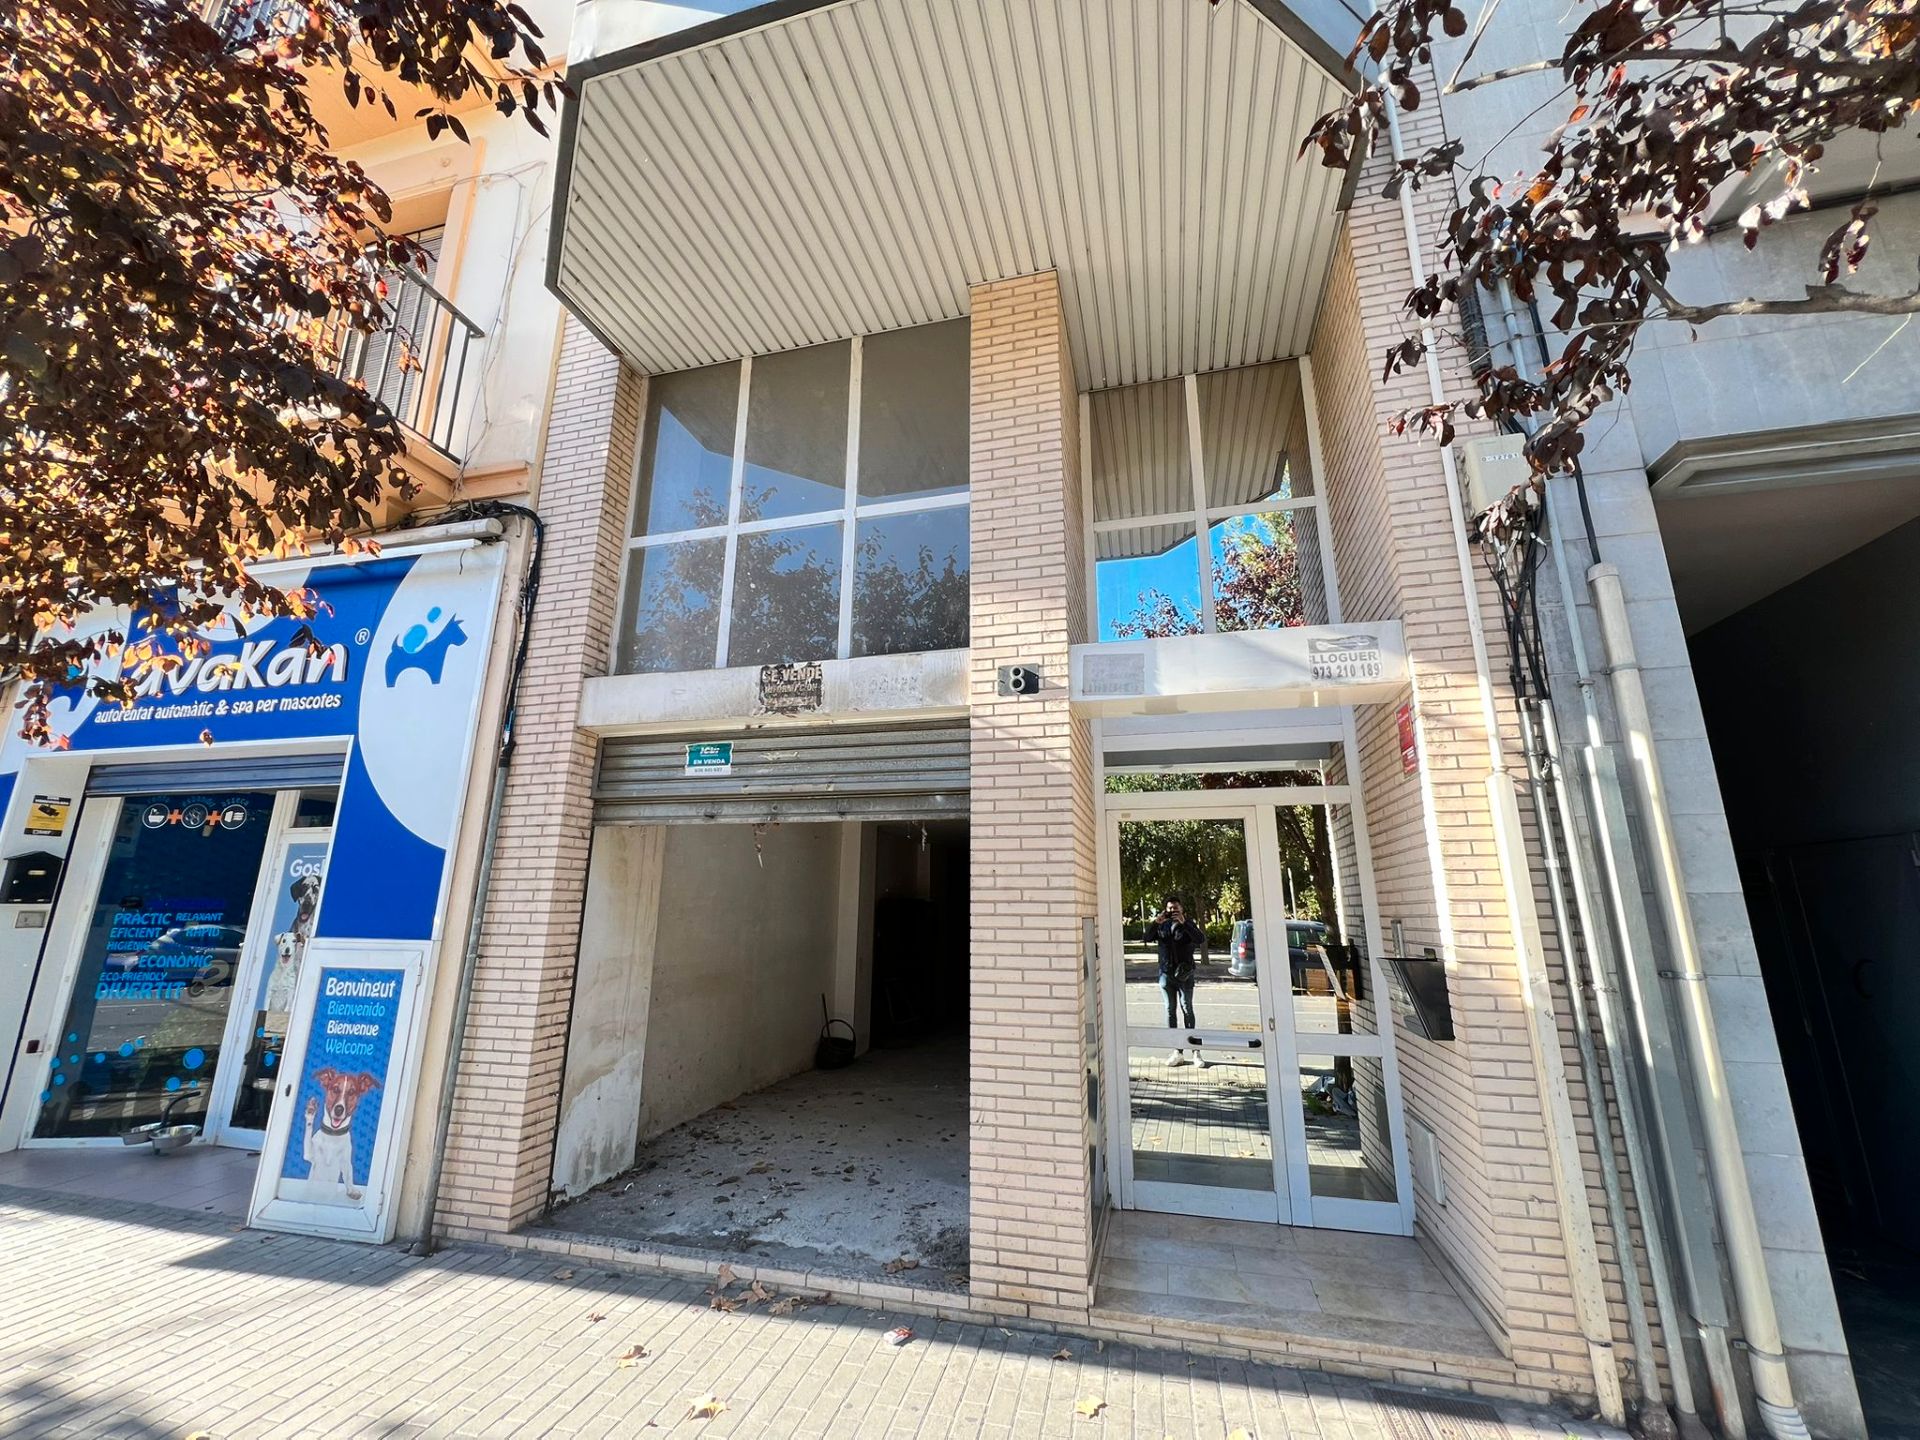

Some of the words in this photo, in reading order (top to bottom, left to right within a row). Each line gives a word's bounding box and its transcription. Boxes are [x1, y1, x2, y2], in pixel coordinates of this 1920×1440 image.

[1312, 651, 1378, 664] LLOGUER
[116, 639, 349, 698] avaKan
[782, 666, 822, 681] VENDE
[1312, 666, 1333, 680] 973
[1336, 664, 1356, 678] 210
[1360, 662, 1380, 677] 189
[1010, 665, 1026, 692] 8
[154, 700, 214, 719] automàtic
[214, 699, 230, 716] &
[231, 700, 254, 714] spa
[255, 698, 278, 713] per
[279, 692, 341, 711] mascotes
[175, 912, 224, 921] RELAXANT
[109, 927, 162, 938] EFICIENT
[99, 971, 167, 981] ECO-FRIENDLY
[94, 981, 186, 1000] DIVERTIT
[325, 977, 396, 998] Benvingut
[327, 1000, 386, 1017] Bienvenido
[327, 1020, 379, 1036] Bienvenue
[325, 1038, 374, 1056] Welcome
